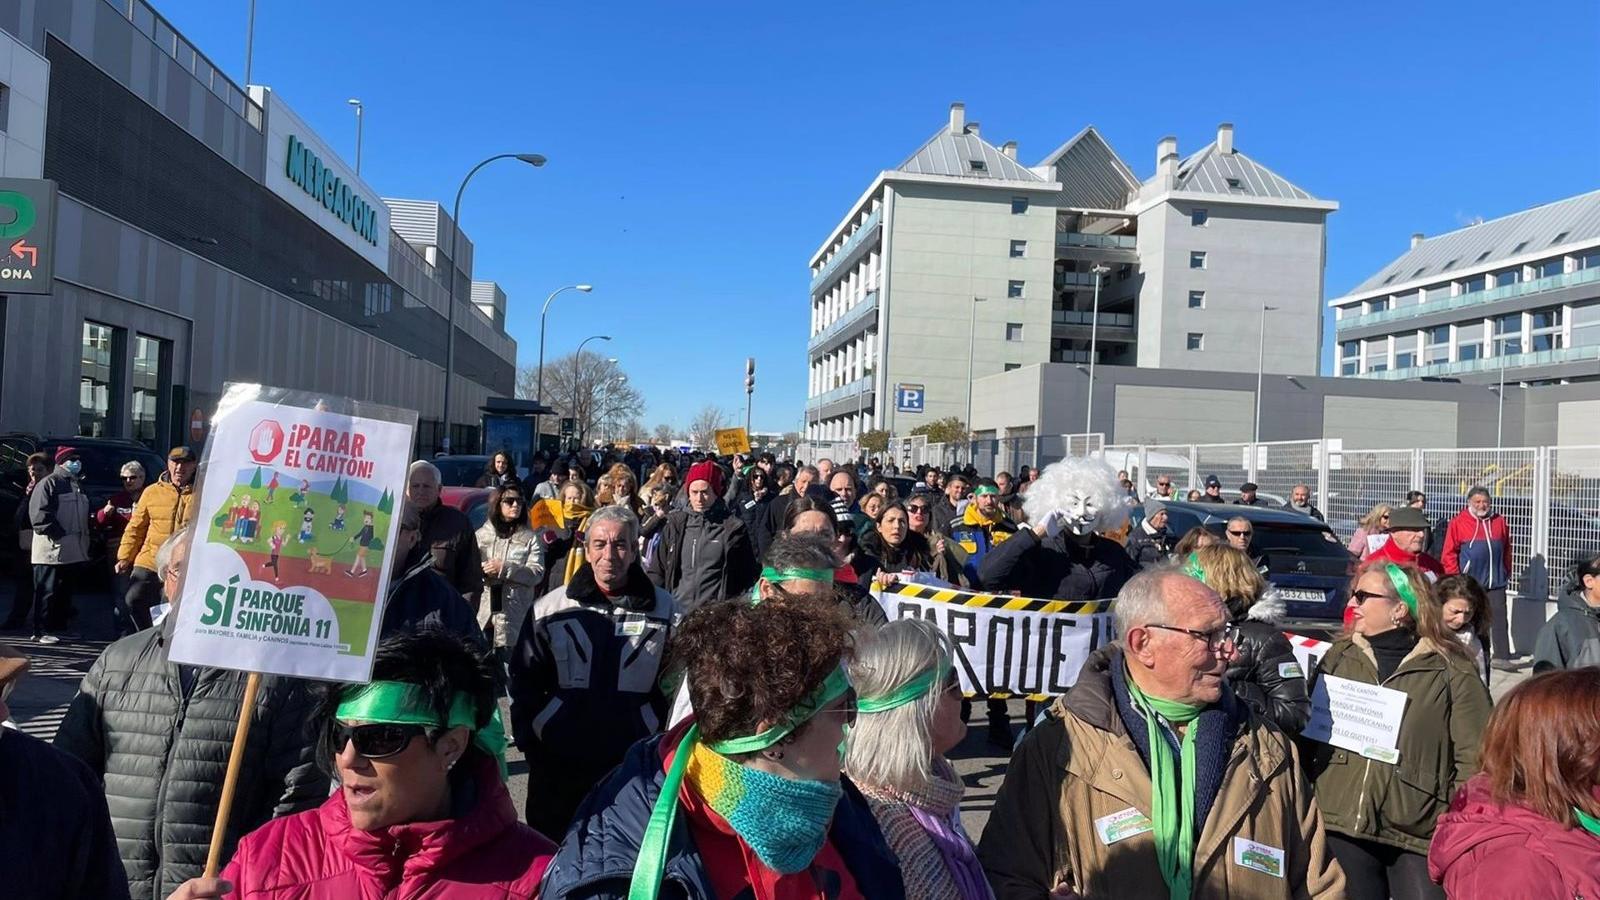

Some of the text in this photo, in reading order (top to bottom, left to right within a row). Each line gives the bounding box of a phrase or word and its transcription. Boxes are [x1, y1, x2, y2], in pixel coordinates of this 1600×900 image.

[286, 134, 379, 247] MERCADONA
[288, 424, 366, 457] ¡PARAR
[284, 449, 374, 479] EL CANTÓN!
[200, 574, 240, 626] SÍ
[240, 588, 305, 615] PARQUE
[235, 610, 332, 639] SINFONÍA 11
[236, 632, 258, 640] FAMILIA
[263, 635, 289, 644] CANINOS
